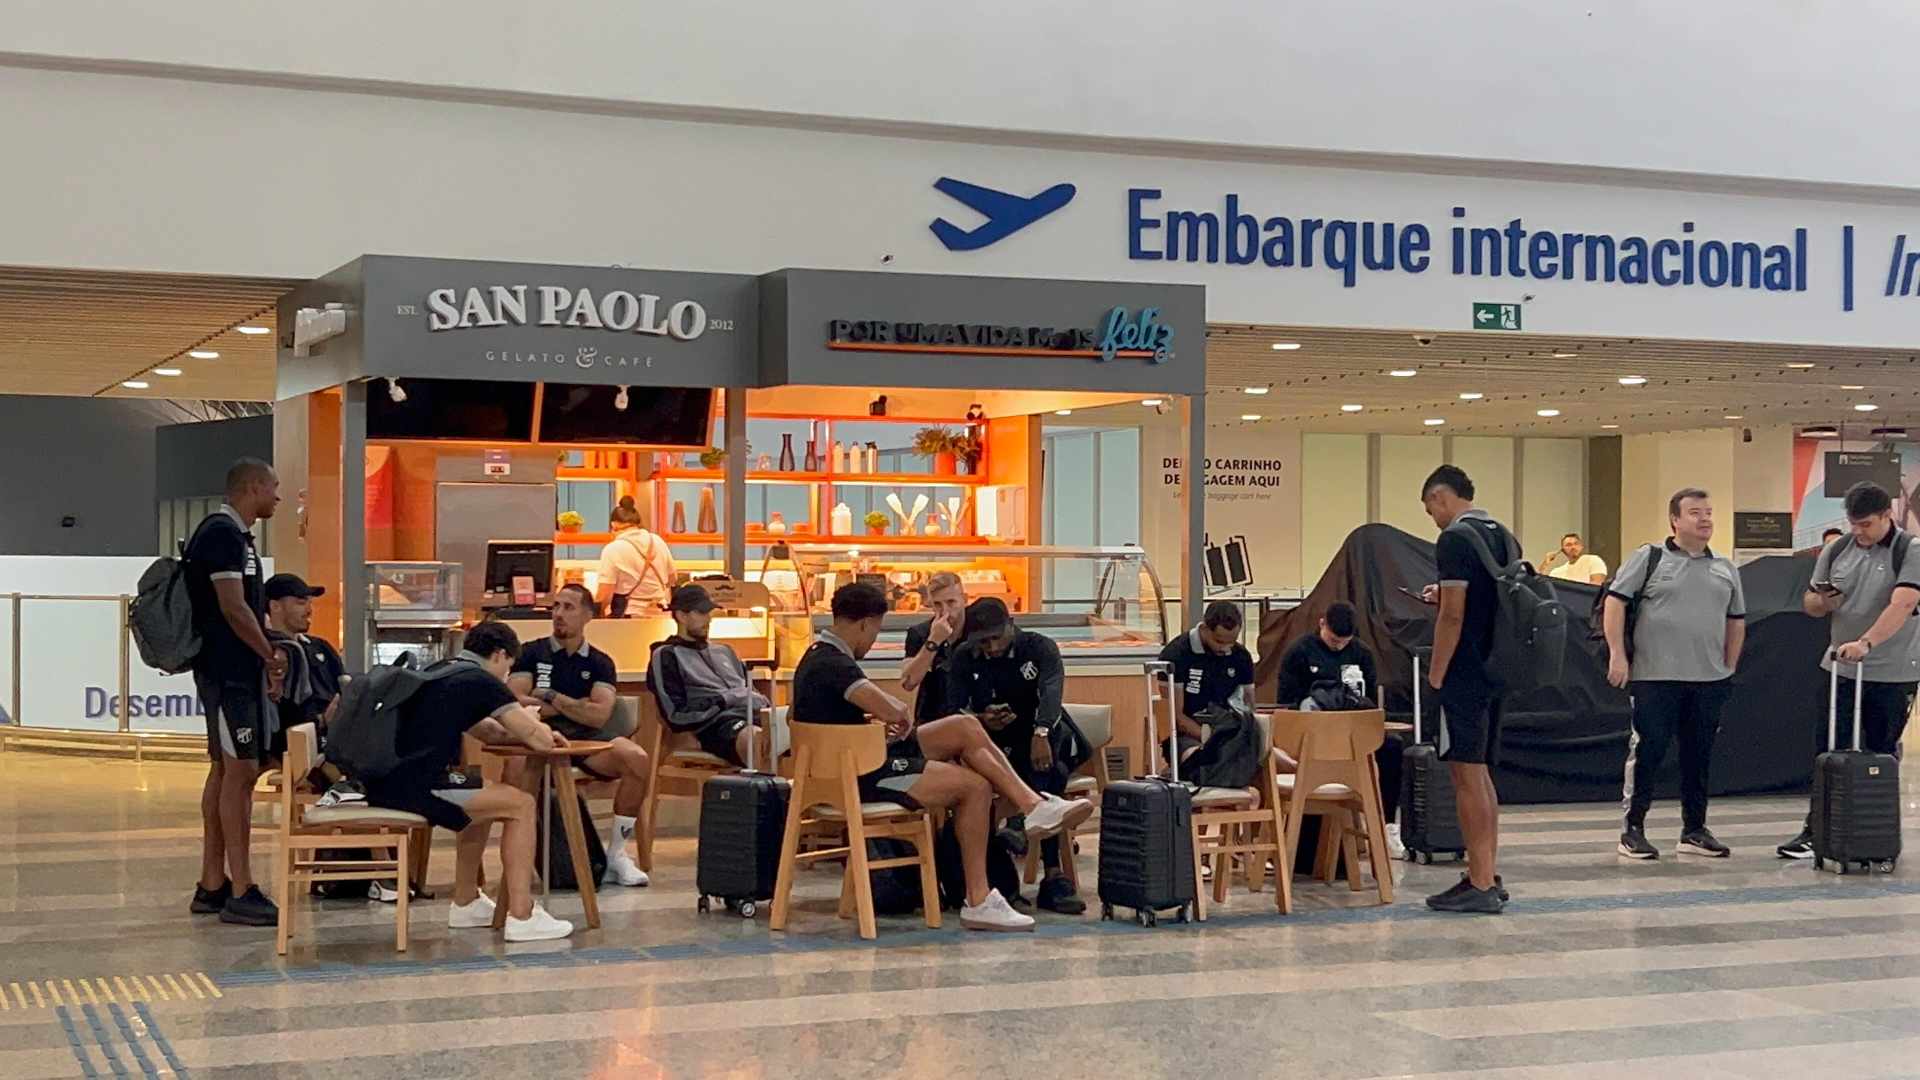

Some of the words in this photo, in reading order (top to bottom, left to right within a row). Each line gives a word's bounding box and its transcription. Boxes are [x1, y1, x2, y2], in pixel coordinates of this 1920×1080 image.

[1127, 188, 1431, 288] Embarque
[1452, 206, 1807, 292] internacional
[427, 285, 528, 332] SAN
[536, 286, 707, 341] PAOLO
[710, 319, 735, 331] 2012
[830, 319, 889, 344] POR
[895, 322, 955, 345] UMA
[956, 324, 1024, 347] VIDA
[1100, 305, 1175, 364] feliz
[486, 351, 565, 364] GELATO
[1215, 459, 1282, 471] CARRINHO
[1164, 474, 1181, 485] DE
[1203, 474, 1245, 486] GAGEM
[1248, 475, 1280, 488] AQUI
